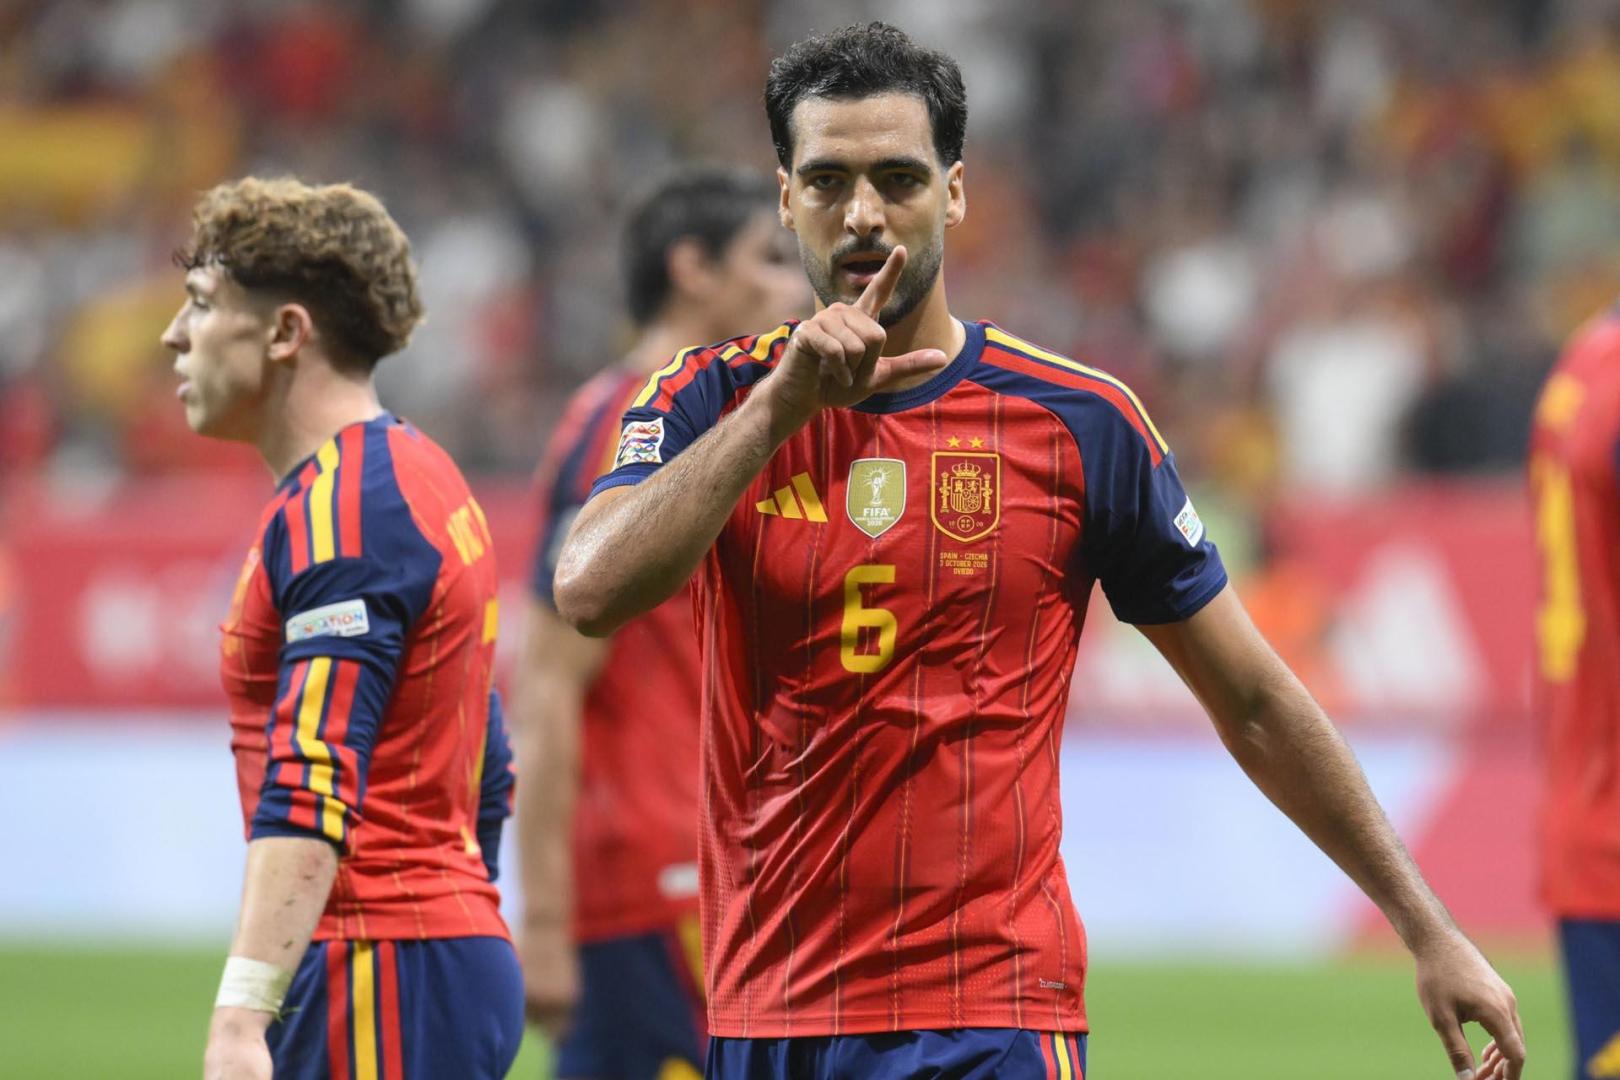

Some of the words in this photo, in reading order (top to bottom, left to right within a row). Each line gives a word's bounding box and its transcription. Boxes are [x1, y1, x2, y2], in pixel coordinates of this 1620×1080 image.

[863, 507, 888, 516] FIFA
[945, 560, 971, 568] OCTOBER
[841, 564, 897, 673] 6
